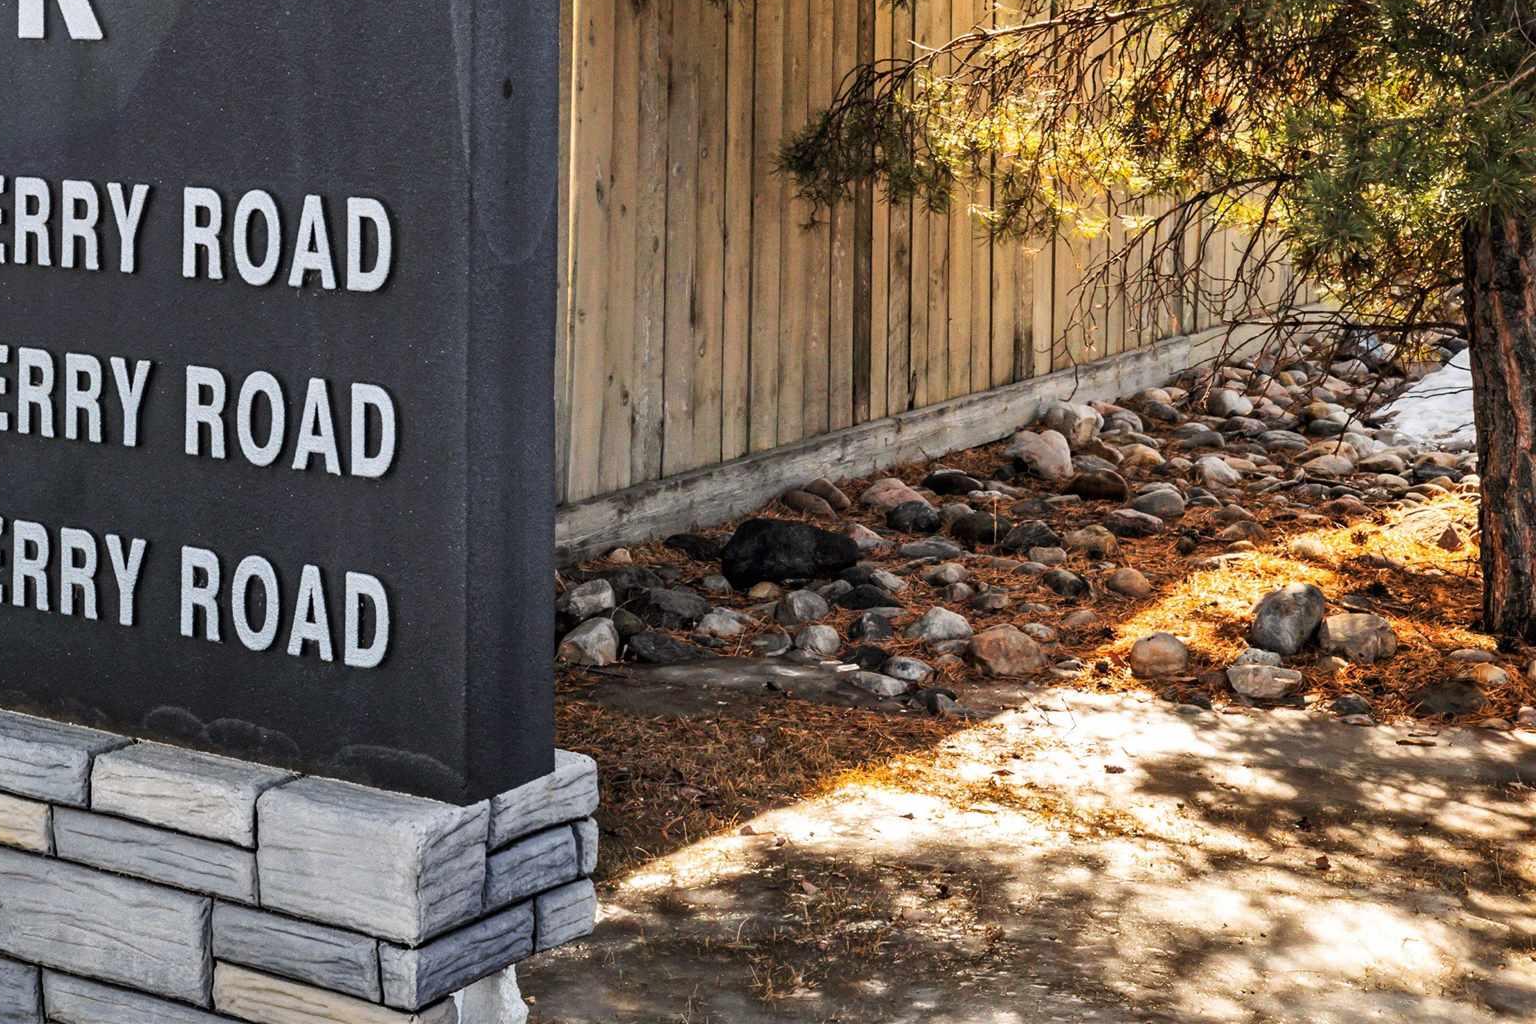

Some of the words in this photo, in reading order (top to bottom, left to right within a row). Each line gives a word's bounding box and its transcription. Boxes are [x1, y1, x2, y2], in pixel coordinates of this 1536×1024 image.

[182, 186, 394, 293] ROAD
[185, 364, 397, 478] ROAD
[180, 545, 391, 669] ROAD
